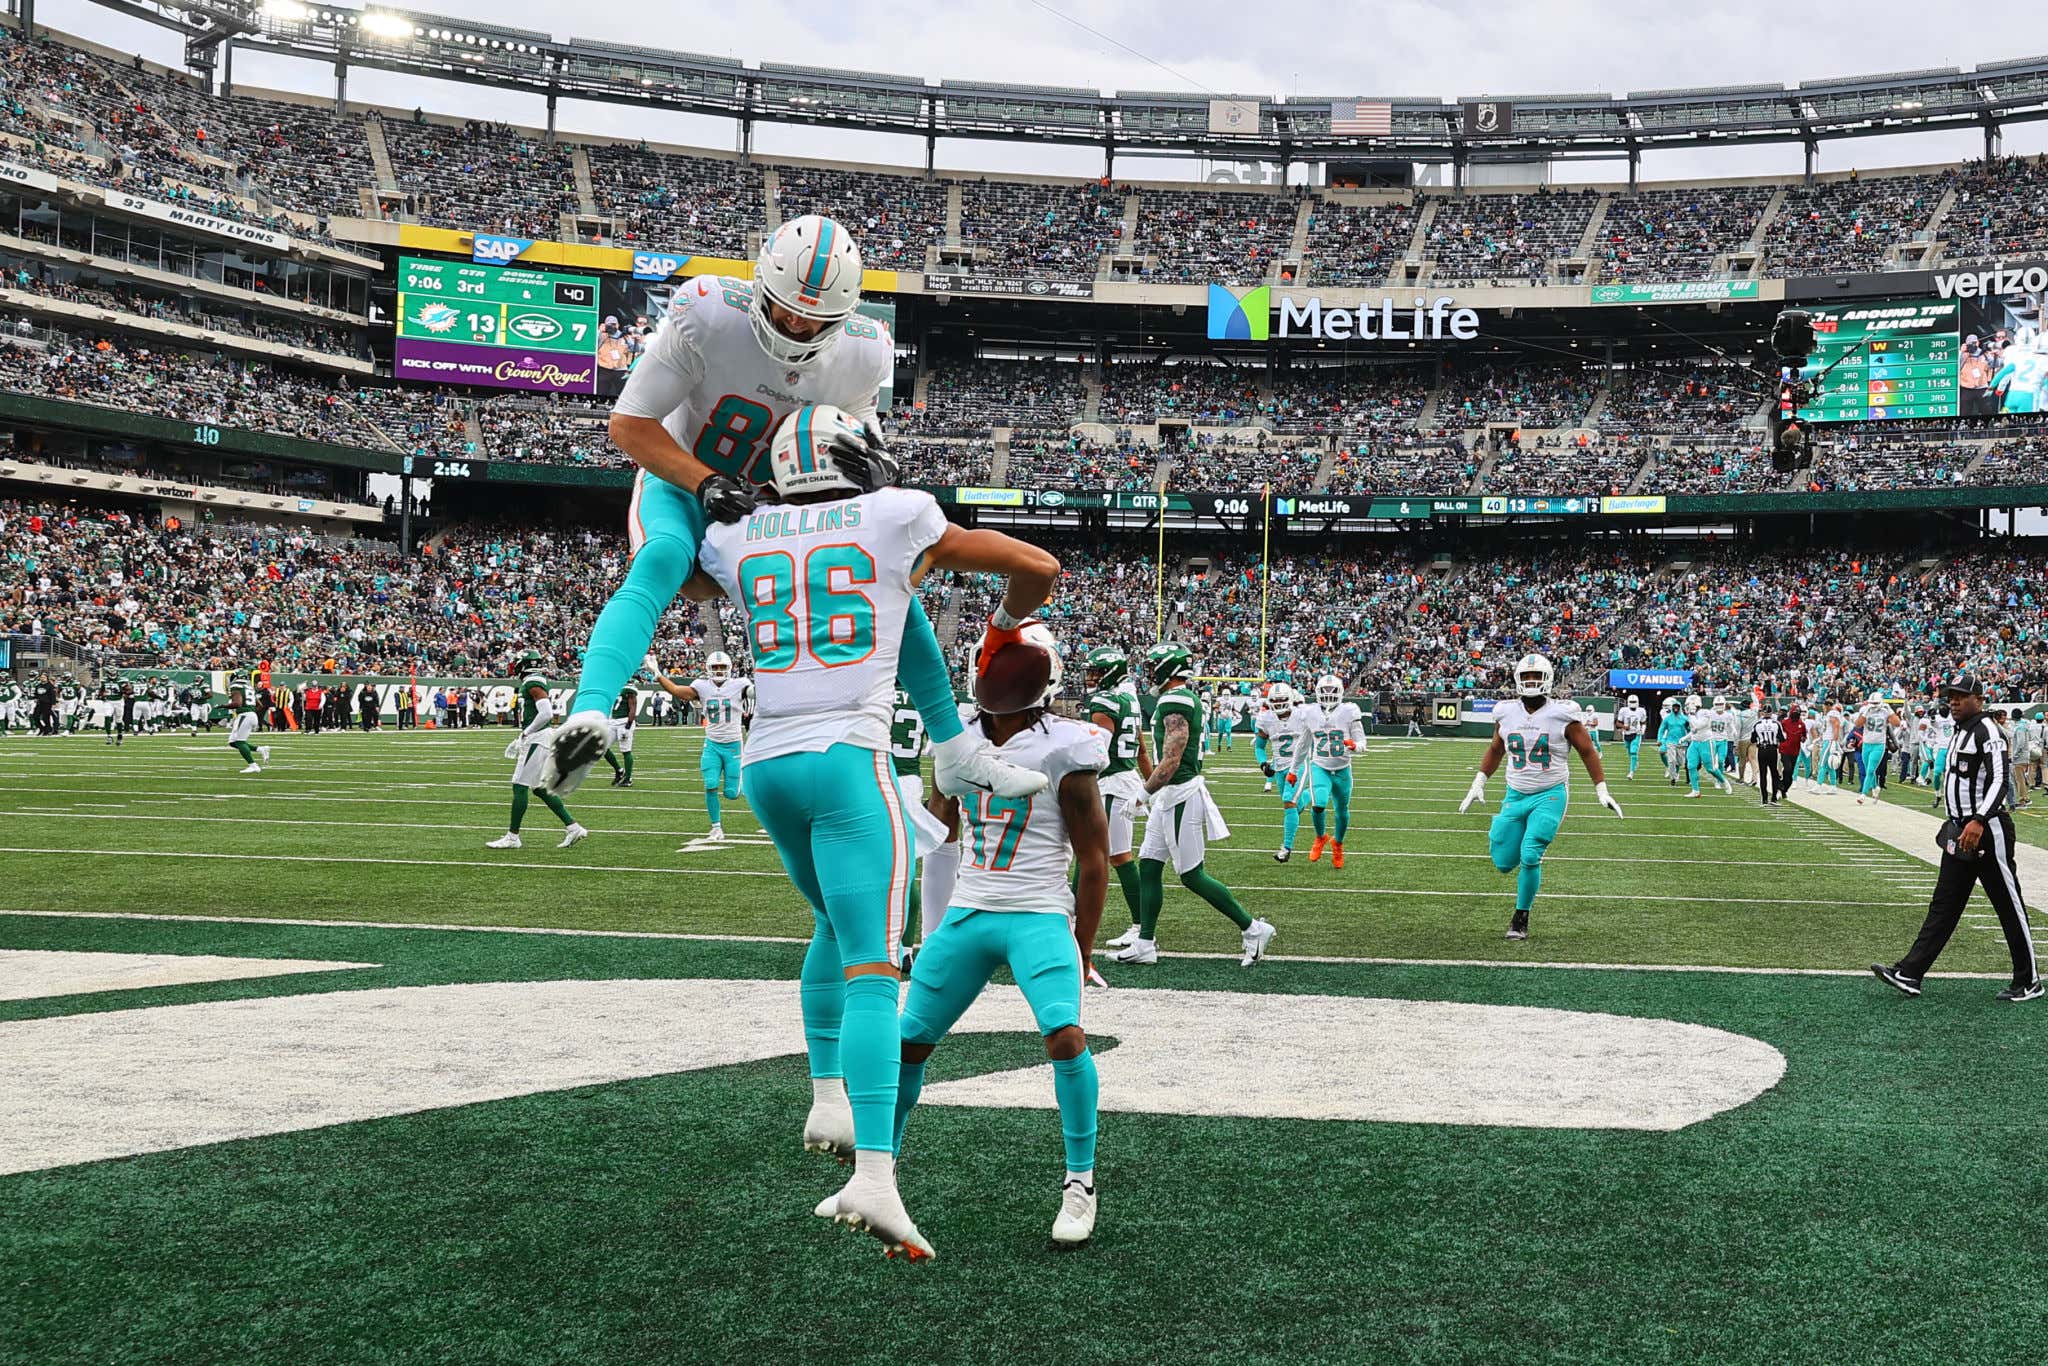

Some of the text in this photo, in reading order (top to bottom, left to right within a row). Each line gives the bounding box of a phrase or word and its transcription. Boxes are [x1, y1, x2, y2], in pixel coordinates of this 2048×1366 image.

[123, 197, 275, 244] 93 MARTY LYONS
[474, 239, 520, 262] SAP
[409, 263, 444, 273] TIME
[458, 269, 486, 278] QTR
[634, 256, 677, 277] SAP
[497, 276, 549, 286] DISTANCE
[929, 275, 950, 283] Need
[929, 282, 952, 290] Help?
[407, 275, 585, 301] 9:06 3rd & 40
[1059, 289, 1092, 297] FIRST
[1630, 284, 1682, 294] SUPER
[1685, 282, 1729, 292] BOWL
[1731, 281, 1751, 290] III
[1651, 290, 1731, 300] CHAMPIONS
[1278, 296, 1480, 340] MetLife
[1842, 304, 1956, 321] AROUND THE
[467, 313, 496, 332] 13
[571, 324, 587, 342] 7
[1865, 317, 1937, 331] LEAGUE
[1872, 342, 1887, 351] W
[1904, 341, 1914, 349] 21
[1905, 352, 1948, 362] 14 9:21
[402, 358, 591, 387] KICK OFF WITH Crown Royal
[1931, 367, 1947, 375] 3RD
[1927, 379, 1951, 388] 11:54
[1842, 398, 1857, 406] 3RD
[1904, 394, 1914, 402] 10
[1931, 394, 1947, 402] 3RD
[1817, 409, 1859, 419] 3 8:49
[1928, 406, 1948, 415] 9:13
[434, 461, 471, 478] 2:54
[156, 485, 193, 499] verizon
[964, 490, 1016, 503] Butterfinger
[1102, 494, 1113, 507] 7
[1132, 496, 1158, 508] QTR
[1214, 499, 1249, 514] 9:06
[1298, 500, 1350, 514] MetLife
[1400, 503, 1410, 514] &
[1434, 502, 1450, 511] BALL
[1455, 502, 1468, 511] ON
[1486, 501, 1500, 512] 40
[1509, 499, 1526, 512] 13
[1607, 498, 1659, 511] Butterfinger
[1027, 497, 1034, 505] 3
[1591, 504, 1597, 512] 3
[746, 502, 862, 542] HOLLINS
[737, 542, 877, 674] 86
[1639, 674, 1685, 685] FANDUEL
[1438, 706, 1456, 719] 40
[1866, 716, 1885, 734] 92
[1278, 735, 1294, 758] 2
[1314, 730, 1345, 758] 28
[1507, 732, 1552, 771] 94
[961, 790, 1033, 872] 17
